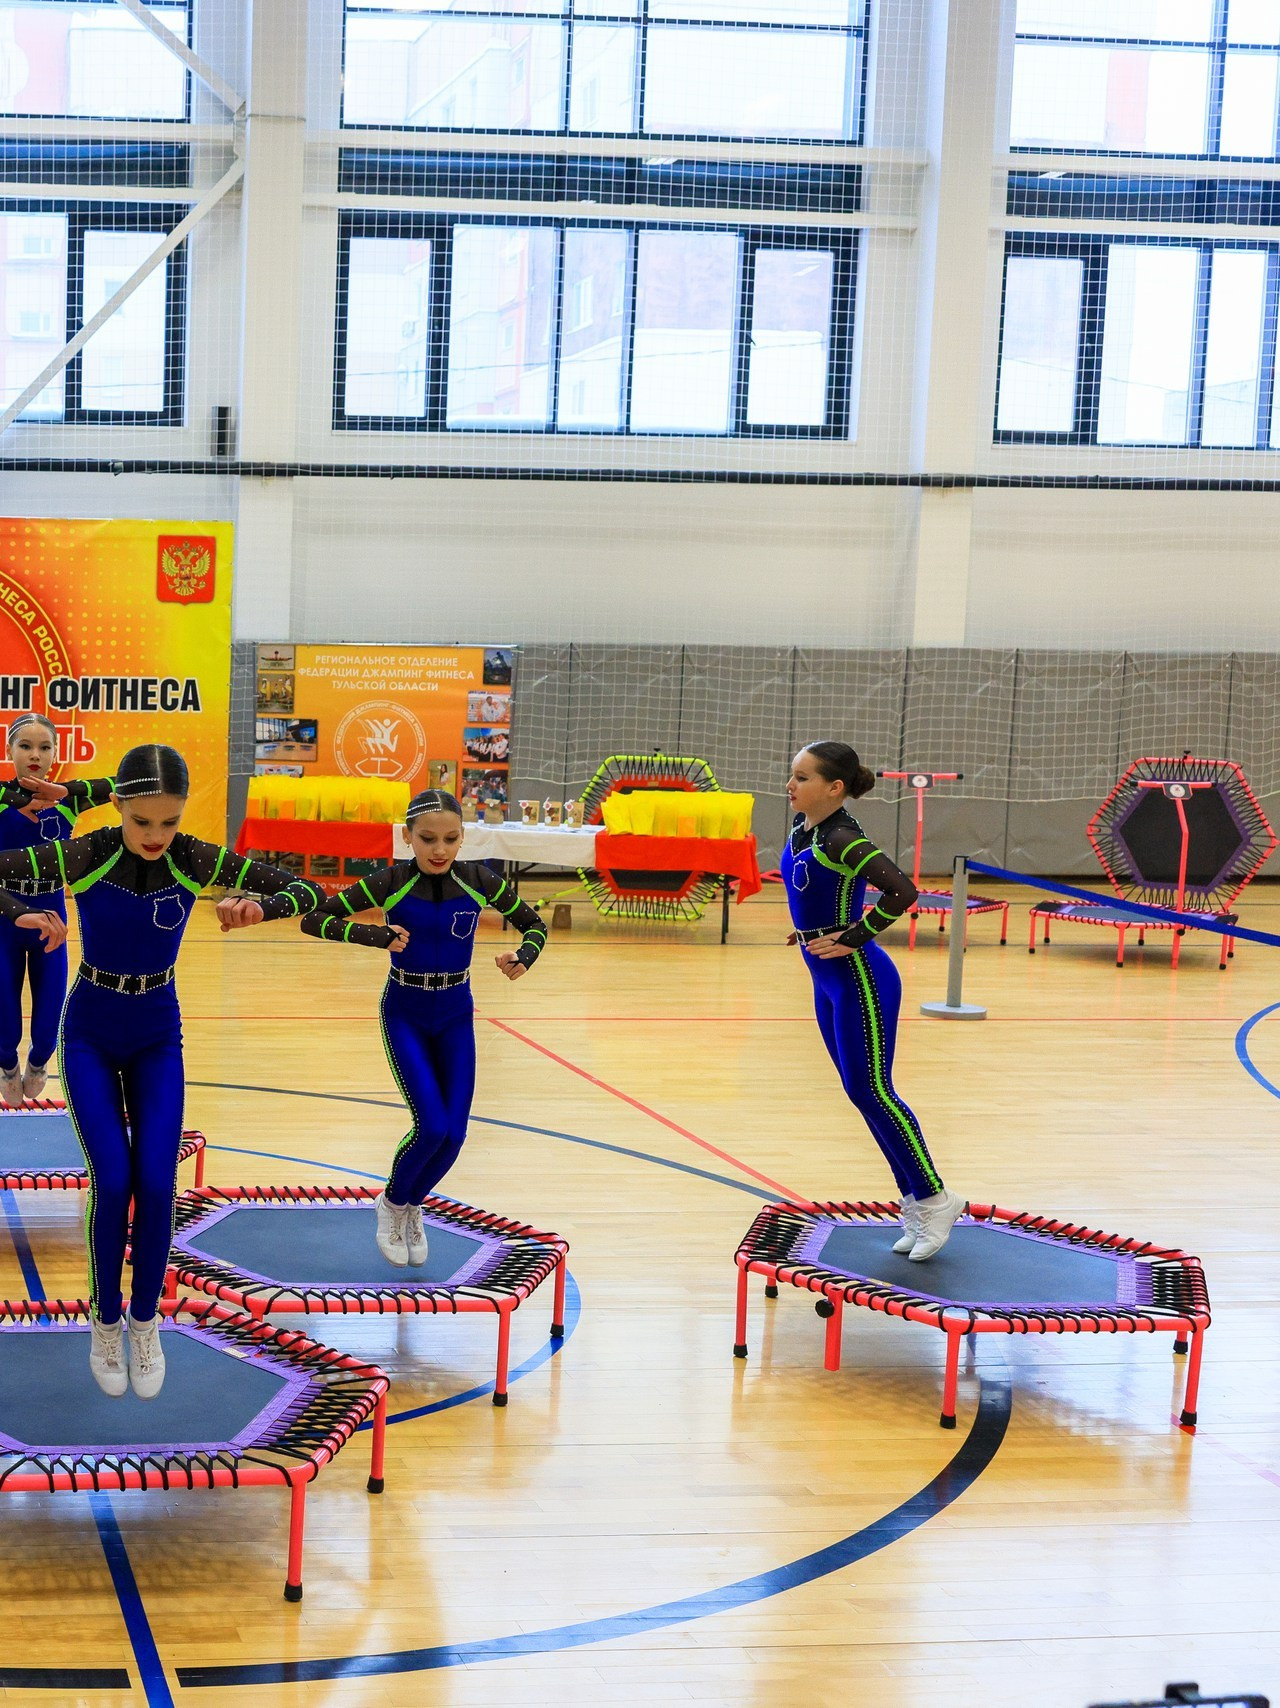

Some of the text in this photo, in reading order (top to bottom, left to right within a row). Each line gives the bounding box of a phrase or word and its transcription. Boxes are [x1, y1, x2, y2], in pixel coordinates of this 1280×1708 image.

[32, 625, 64, 679] РОСС
[315, 655, 458, 667] РЕГИОНАЛЬНОЕ ОТДЕЛЕНИЕ
[298, 667, 475, 680] ФЕДЕРАЦИИ ДЖАМПИНГ ФИТНЕСА
[332, 679, 439, 691] ТУЛЬСКОЙ ОБЛАСТИ
[47, 676, 202, 712] ФИТНЕСА
